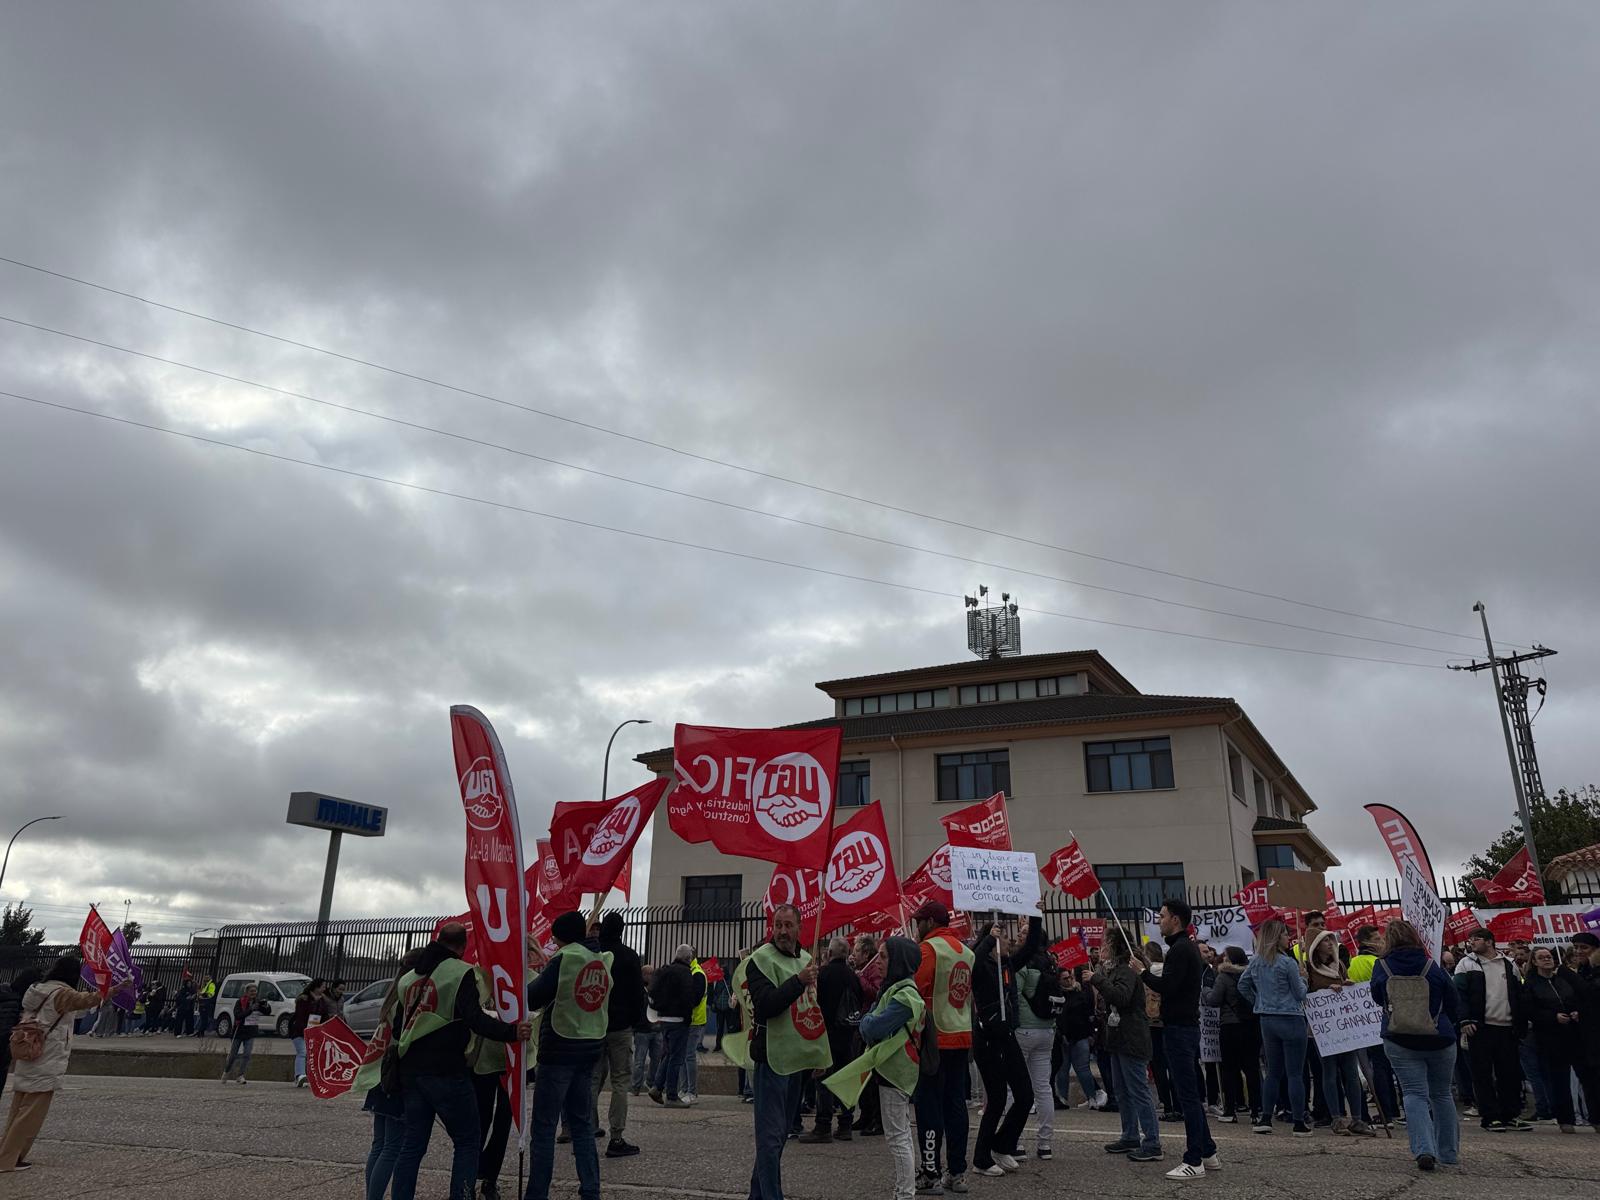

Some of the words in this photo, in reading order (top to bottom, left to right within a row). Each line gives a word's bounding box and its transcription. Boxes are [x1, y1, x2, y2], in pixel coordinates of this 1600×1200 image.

[465, 769, 498, 799] UGT
[317, 798, 382, 832] MAHLE
[967, 869, 1020, 882] MAHLE
[1348, 987, 1372, 999] VIDA
[1312, 1021, 1331, 1035] SUS
[1337, 1010, 1383, 1030] GANANCIA
[923, 1129, 936, 1172] didas
